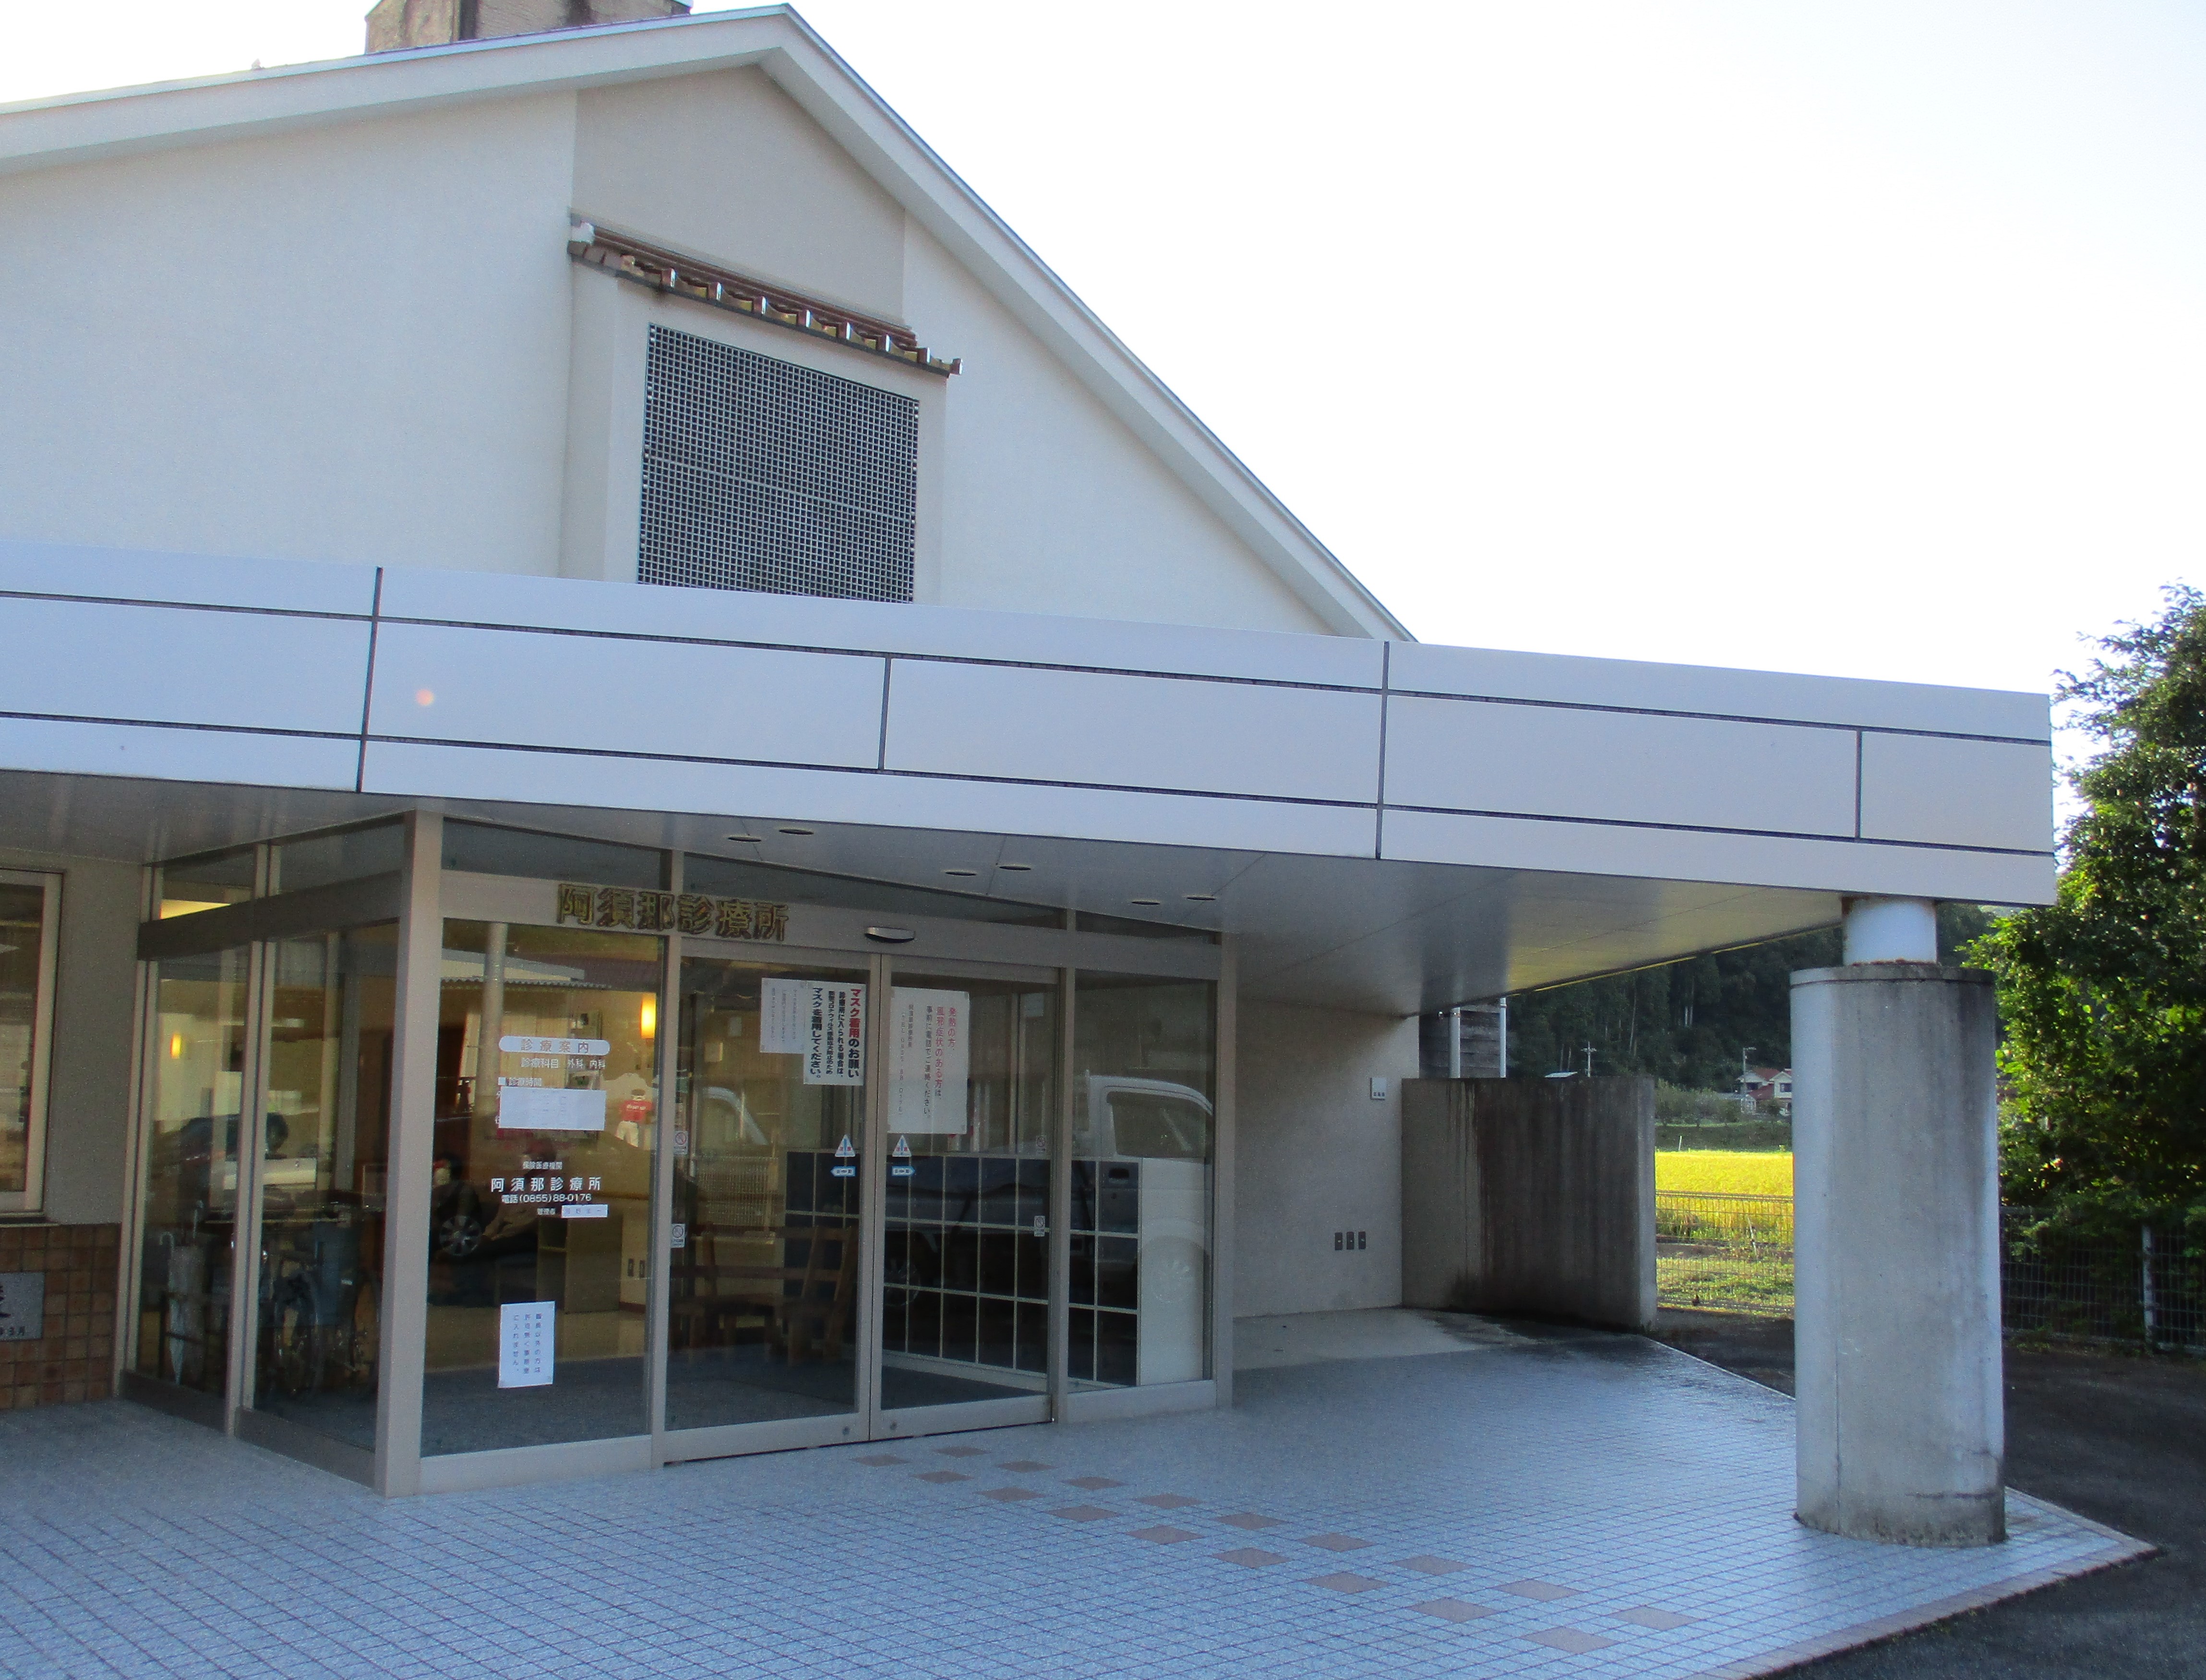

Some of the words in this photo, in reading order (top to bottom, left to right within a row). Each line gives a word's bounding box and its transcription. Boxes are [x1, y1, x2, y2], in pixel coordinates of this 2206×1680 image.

[557, 883, 789, 941] 阿須那診療所
[520, 1038, 589, 1054] 診療案内
[810, 987, 823, 1078] マスクを着用してください。
[848, 989, 862, 1078] マスク着用のお願い
[521, 1057, 559, 1069] 診療科目
[567, 1059, 584, 1069] 外科
[589, 1060, 606, 1069] 内科
[491, 1177, 601, 1192] 阿須那診療所
